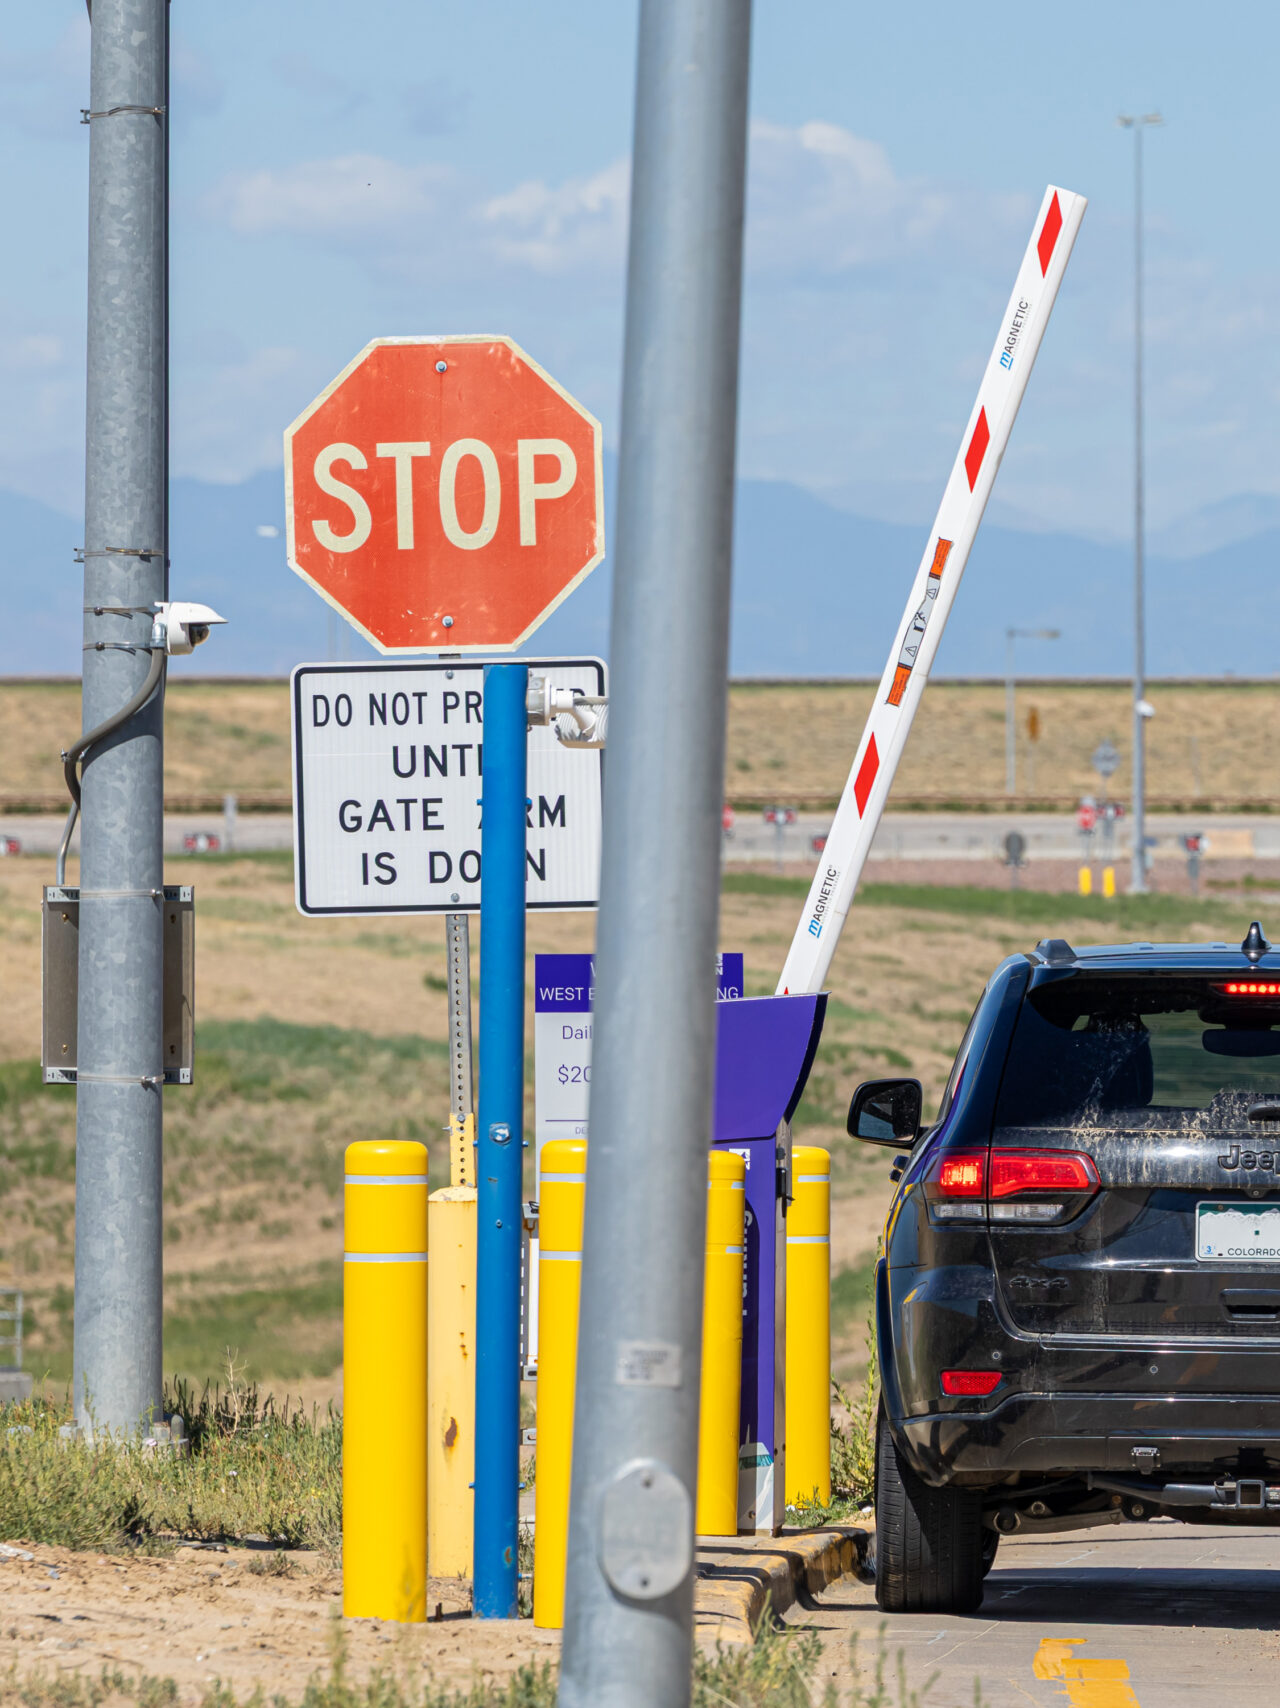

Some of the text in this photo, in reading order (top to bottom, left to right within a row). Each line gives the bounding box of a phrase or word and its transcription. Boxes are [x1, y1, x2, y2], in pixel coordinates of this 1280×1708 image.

[311, 438, 578, 553] STOP
[312, 693, 353, 728] DO
[369, 692, 428, 726] NOT
[392, 744, 483, 779] UNTI
[338, 797, 445, 833] GATE
[361, 848, 546, 886] IS DON
[540, 987, 584, 1001] WEST
[562, 1025, 593, 1040] Dail
